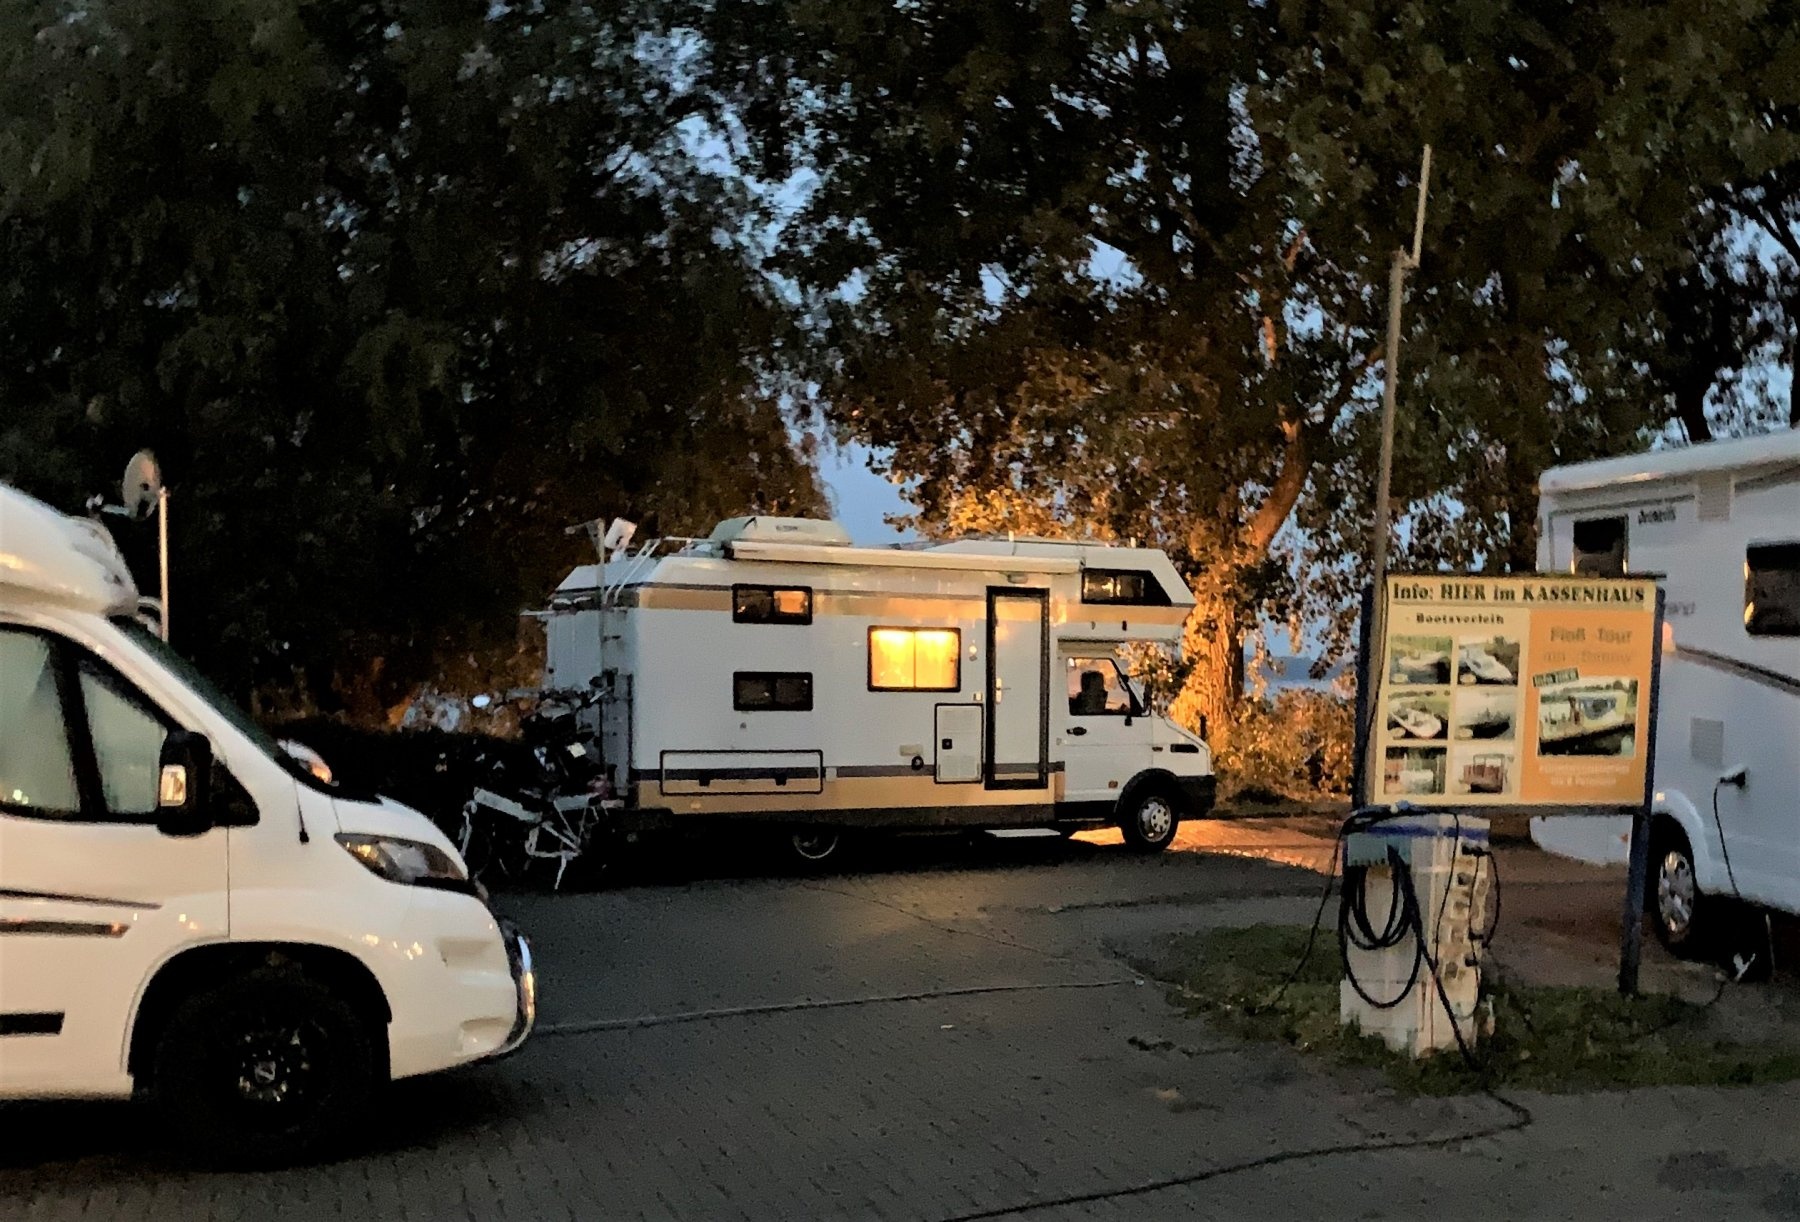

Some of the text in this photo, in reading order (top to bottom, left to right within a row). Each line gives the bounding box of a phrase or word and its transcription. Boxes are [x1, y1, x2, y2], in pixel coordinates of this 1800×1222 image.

[1393, 582, 1645, 603] Info: HIER im KASSENHAUS
[1416, 612, 1505, 624] Bootsverleih
